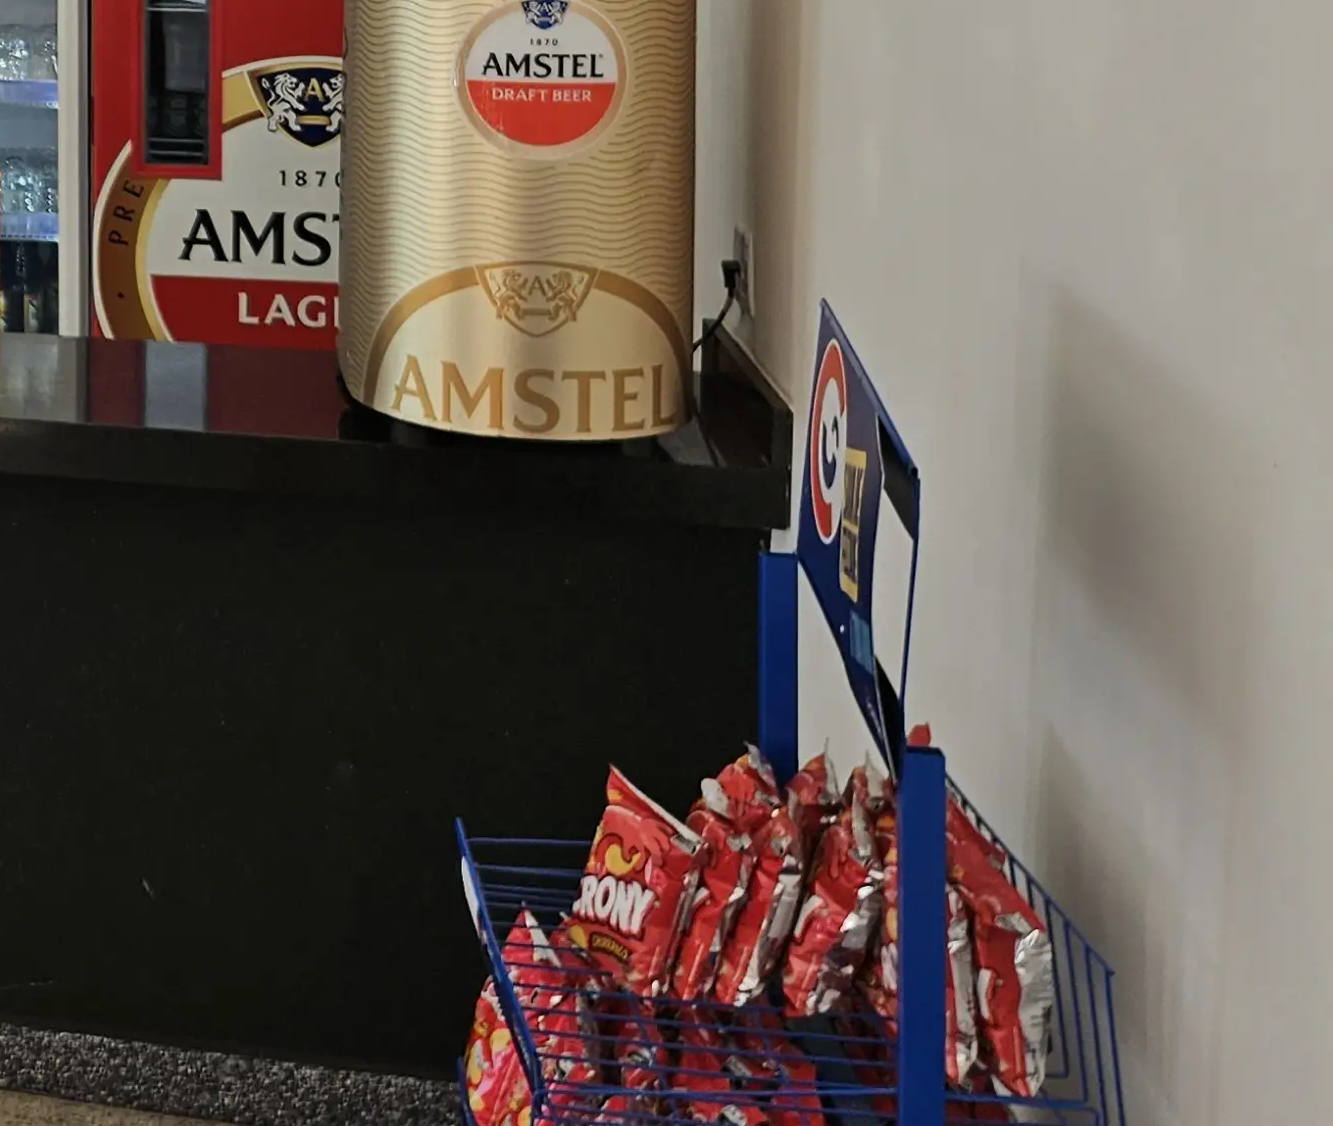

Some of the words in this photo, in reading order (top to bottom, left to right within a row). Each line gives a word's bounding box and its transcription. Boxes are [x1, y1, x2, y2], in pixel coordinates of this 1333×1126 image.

[530, 38, 559, 46] 1870
[481, 52, 604, 78] AMSTEL
[492, 88, 548, 102] DRAFT
[553, 89, 592, 102] BEER
[178, 208, 340, 267] AMS
[238, 292, 339, 328] LAG
[391, 353, 675, 434] AMSTEL
[572, 874, 654, 936] RONY
